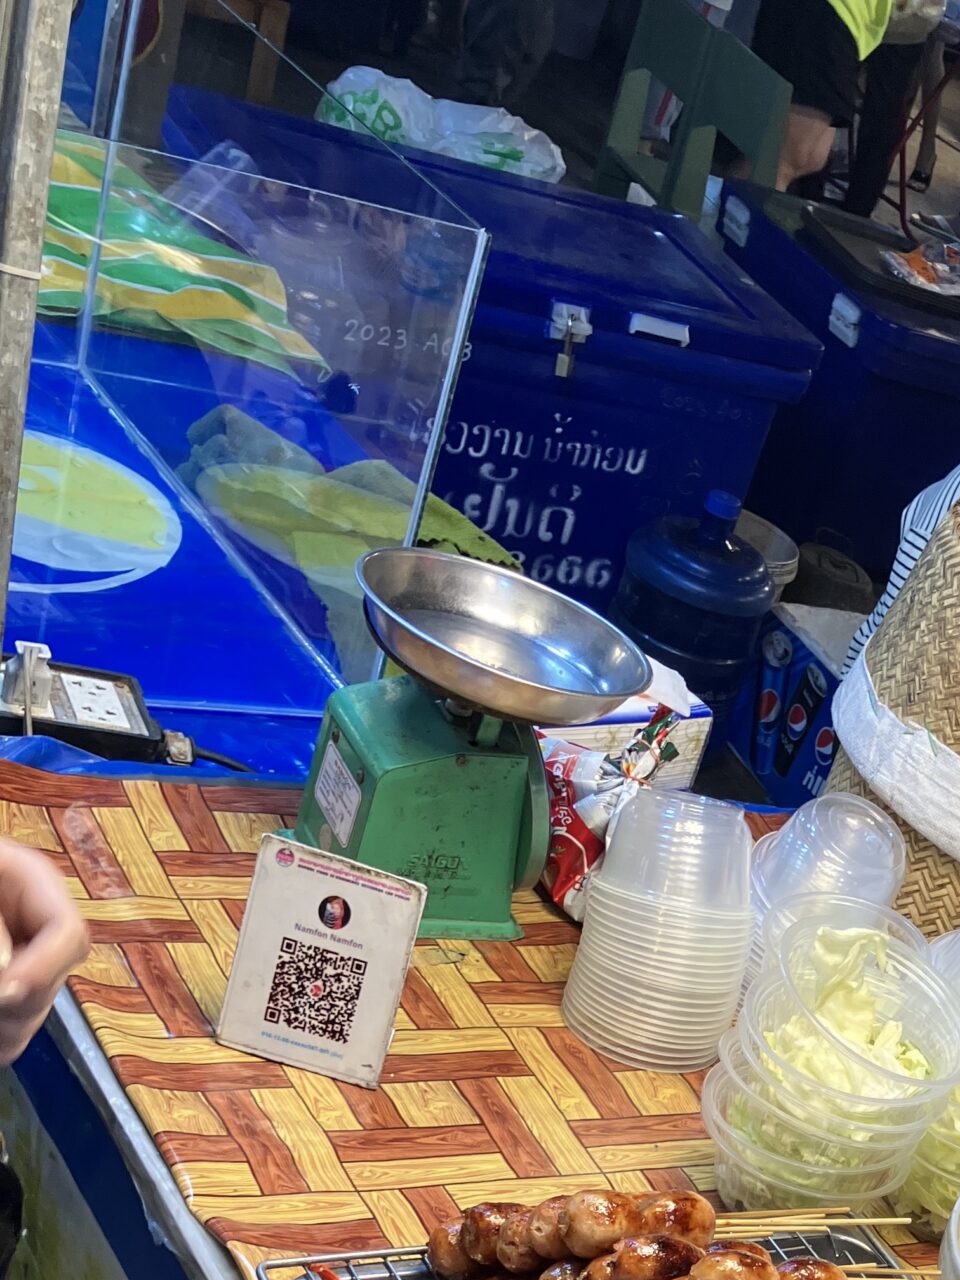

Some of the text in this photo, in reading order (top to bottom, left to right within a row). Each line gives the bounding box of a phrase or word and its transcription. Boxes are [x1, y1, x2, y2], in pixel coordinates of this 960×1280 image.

[343, 319, 407, 350] 2023
[294, 922, 364, 950] Namfon Namfon
